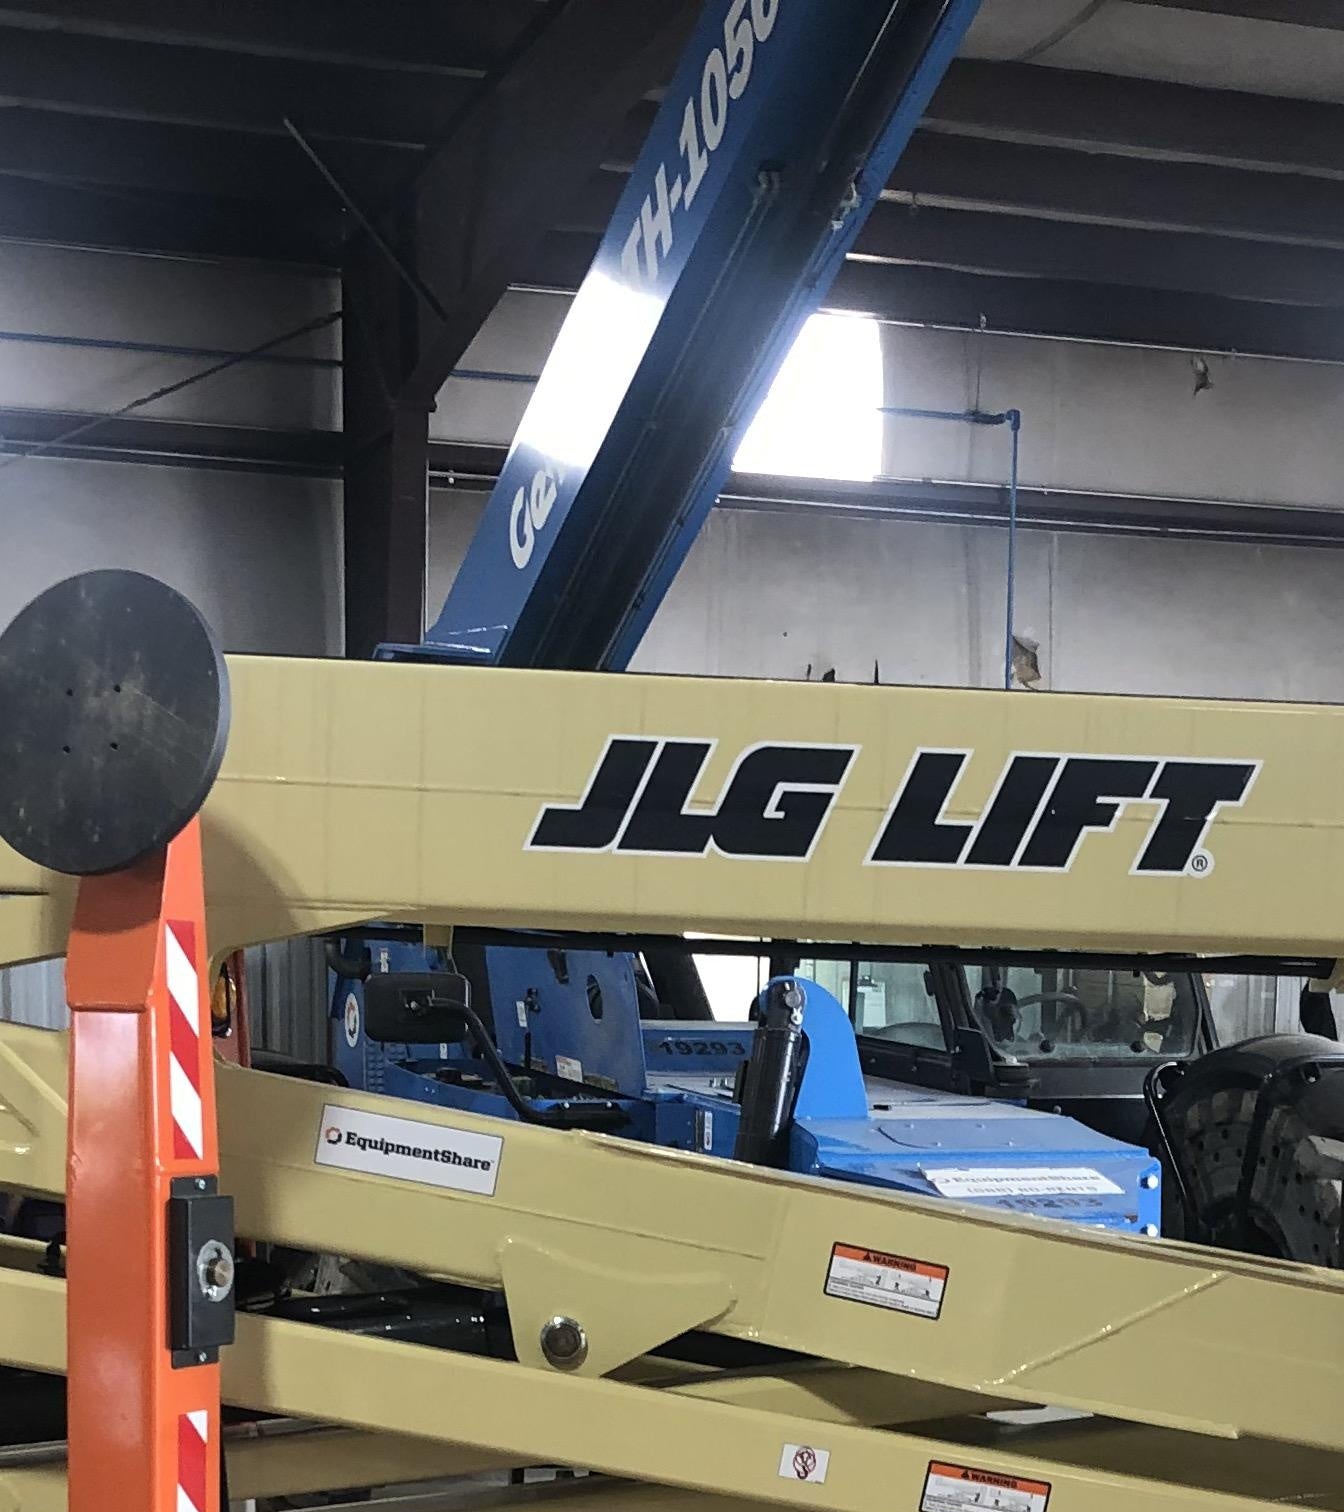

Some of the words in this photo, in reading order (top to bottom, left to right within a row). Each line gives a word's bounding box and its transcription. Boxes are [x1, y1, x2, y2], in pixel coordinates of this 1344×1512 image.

[523, 733, 862, 861] JLG
[863, 748, 1263, 876] LIFT
[345, 1131, 492, 1172] EquipmentShare
[971, 1472, 1018, 1489] WARNING
